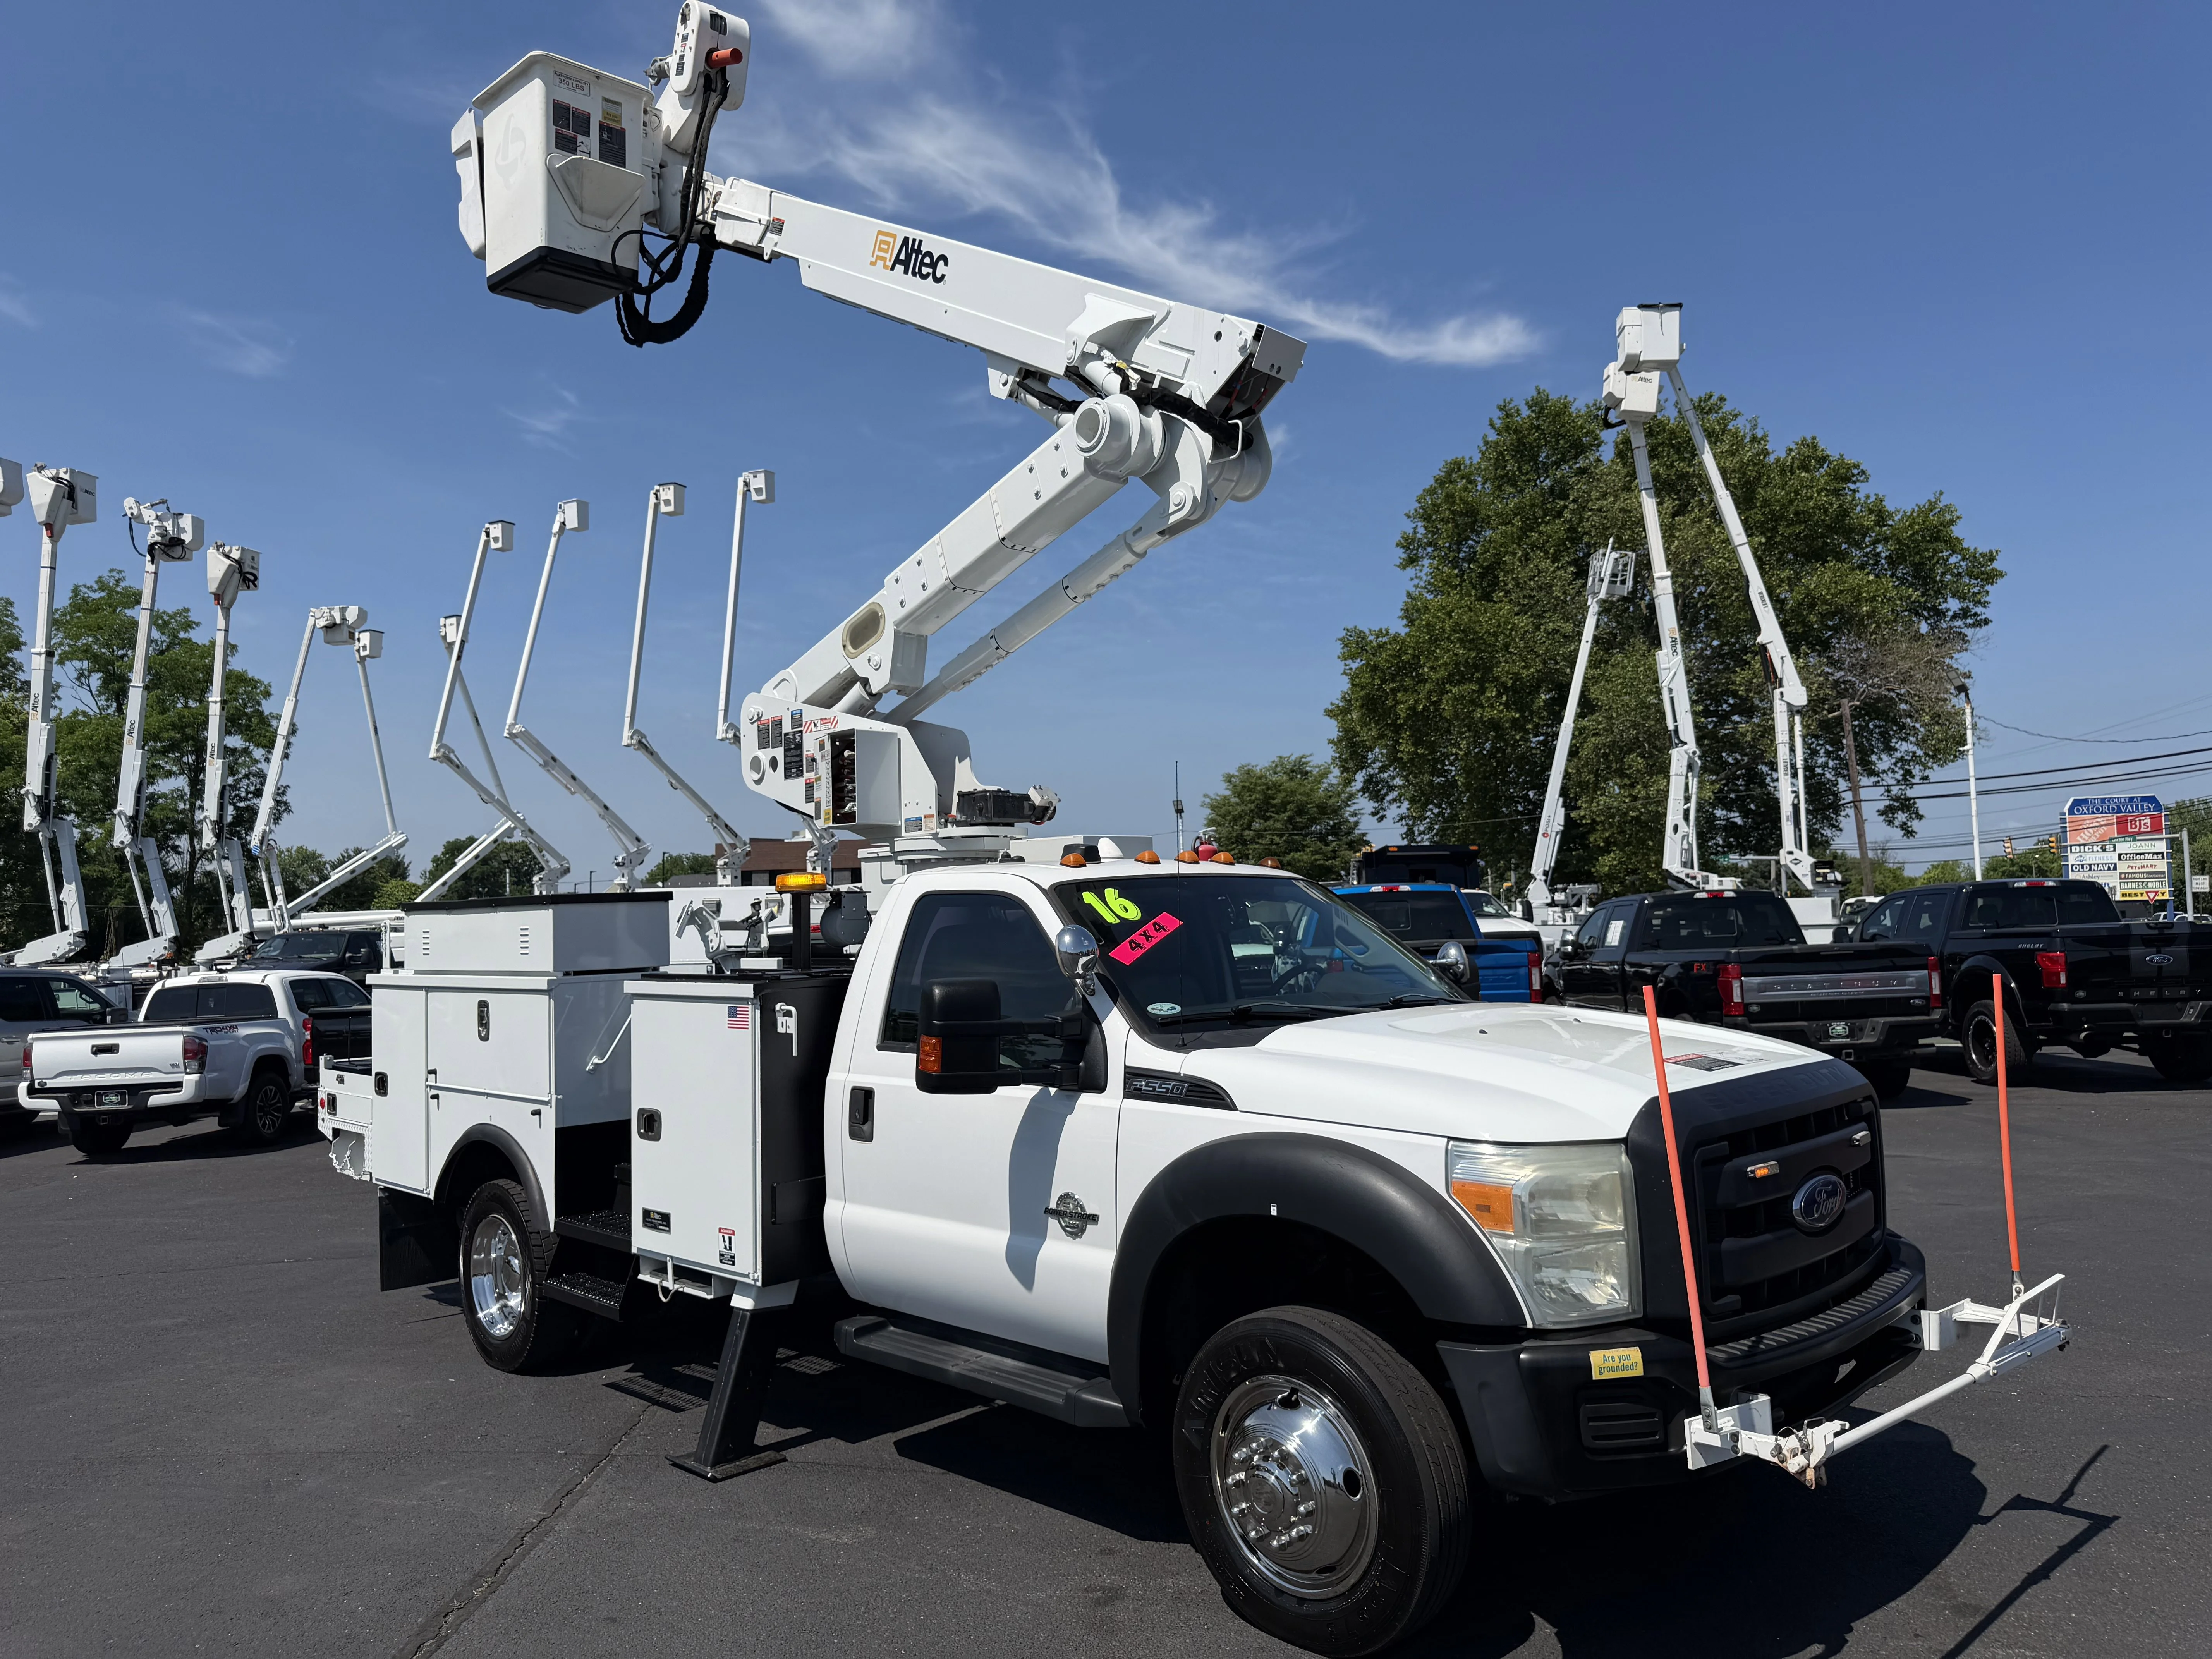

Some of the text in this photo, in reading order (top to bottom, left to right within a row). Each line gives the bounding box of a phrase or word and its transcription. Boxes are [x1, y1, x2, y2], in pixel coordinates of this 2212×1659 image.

[558, 78, 570, 86] 350
[572, 82, 584, 91] LBS
[890, 235, 949, 284] Altec
[1668, 636, 1679, 657] Altec
[127, 719, 136, 738] Altec
[2074, 803, 2155, 814] OXFORD VALLEY
[1082, 888, 1141, 924] 16
[69, 1072, 153, 1082] TACOMA
[1795, 1066, 1847, 1089] DUTY
[1127, 1078, 1188, 1097] F-550
[1814, 1185, 1840, 1218] Ford
[1044, 1207, 1097, 1221] POWER STROKE
[1598, 1362, 1638, 1375] grounded?
[1602, 1354, 1631, 1364] Are you
